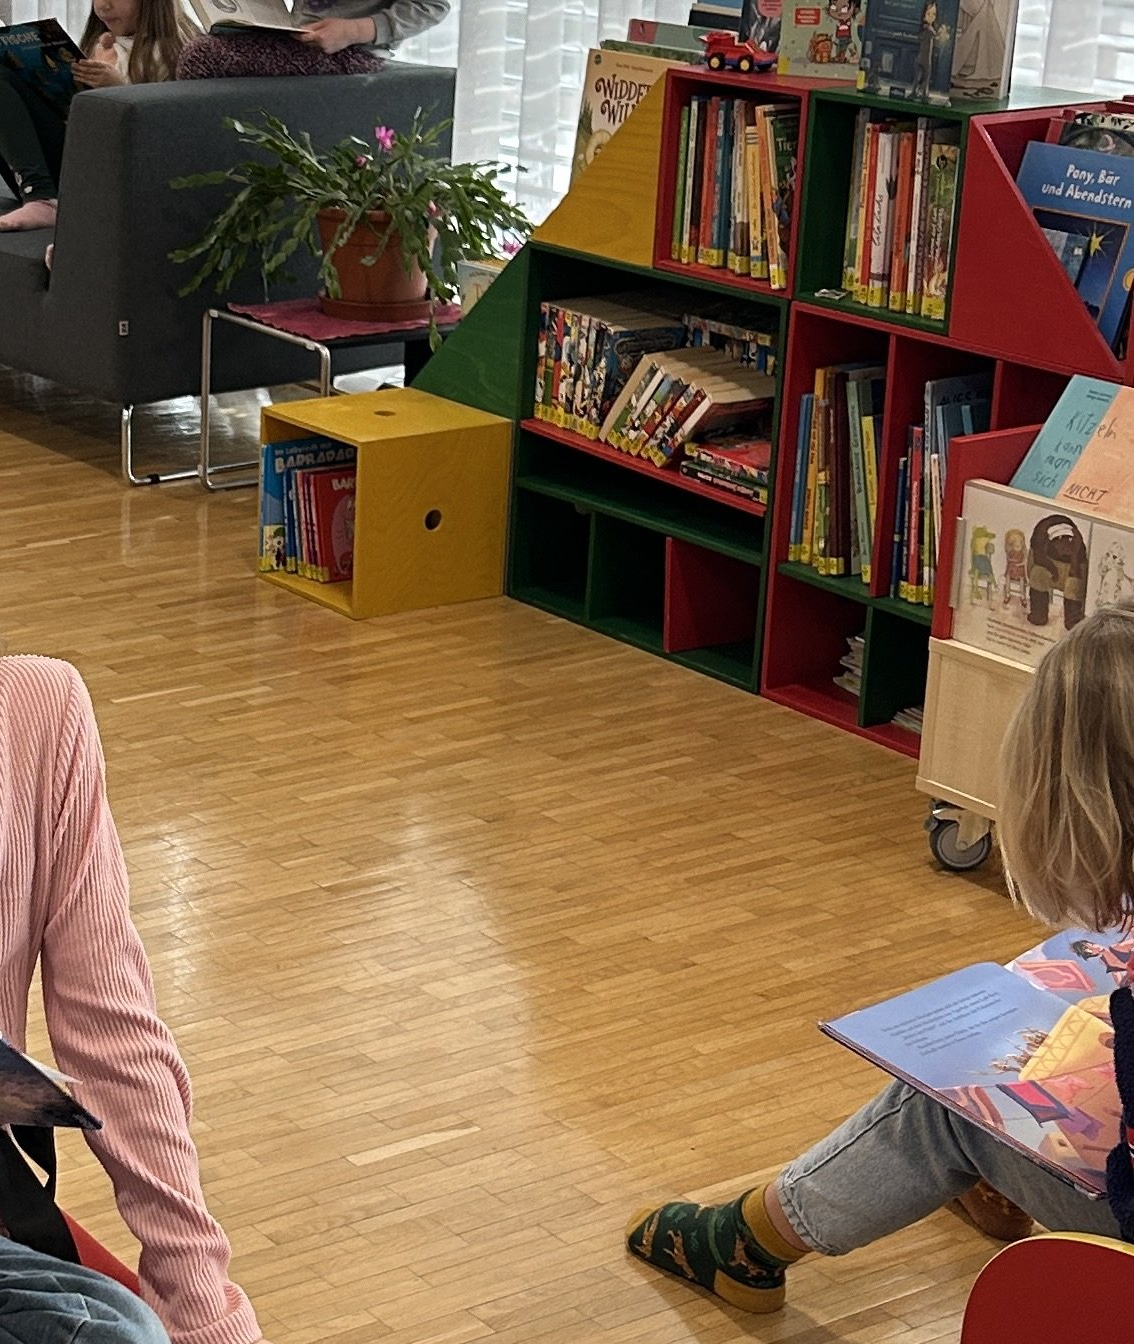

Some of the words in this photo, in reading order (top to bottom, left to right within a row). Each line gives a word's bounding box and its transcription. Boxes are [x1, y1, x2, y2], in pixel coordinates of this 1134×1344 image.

[1067, 164, 1095, 185] Pony,
[1097, 169, 1120, 186] Bär
[1041, 182, 1064, 196] und
[1066, 184, 1133, 209] Abendstern
[1067, 483, 1110, 501] NICHT
